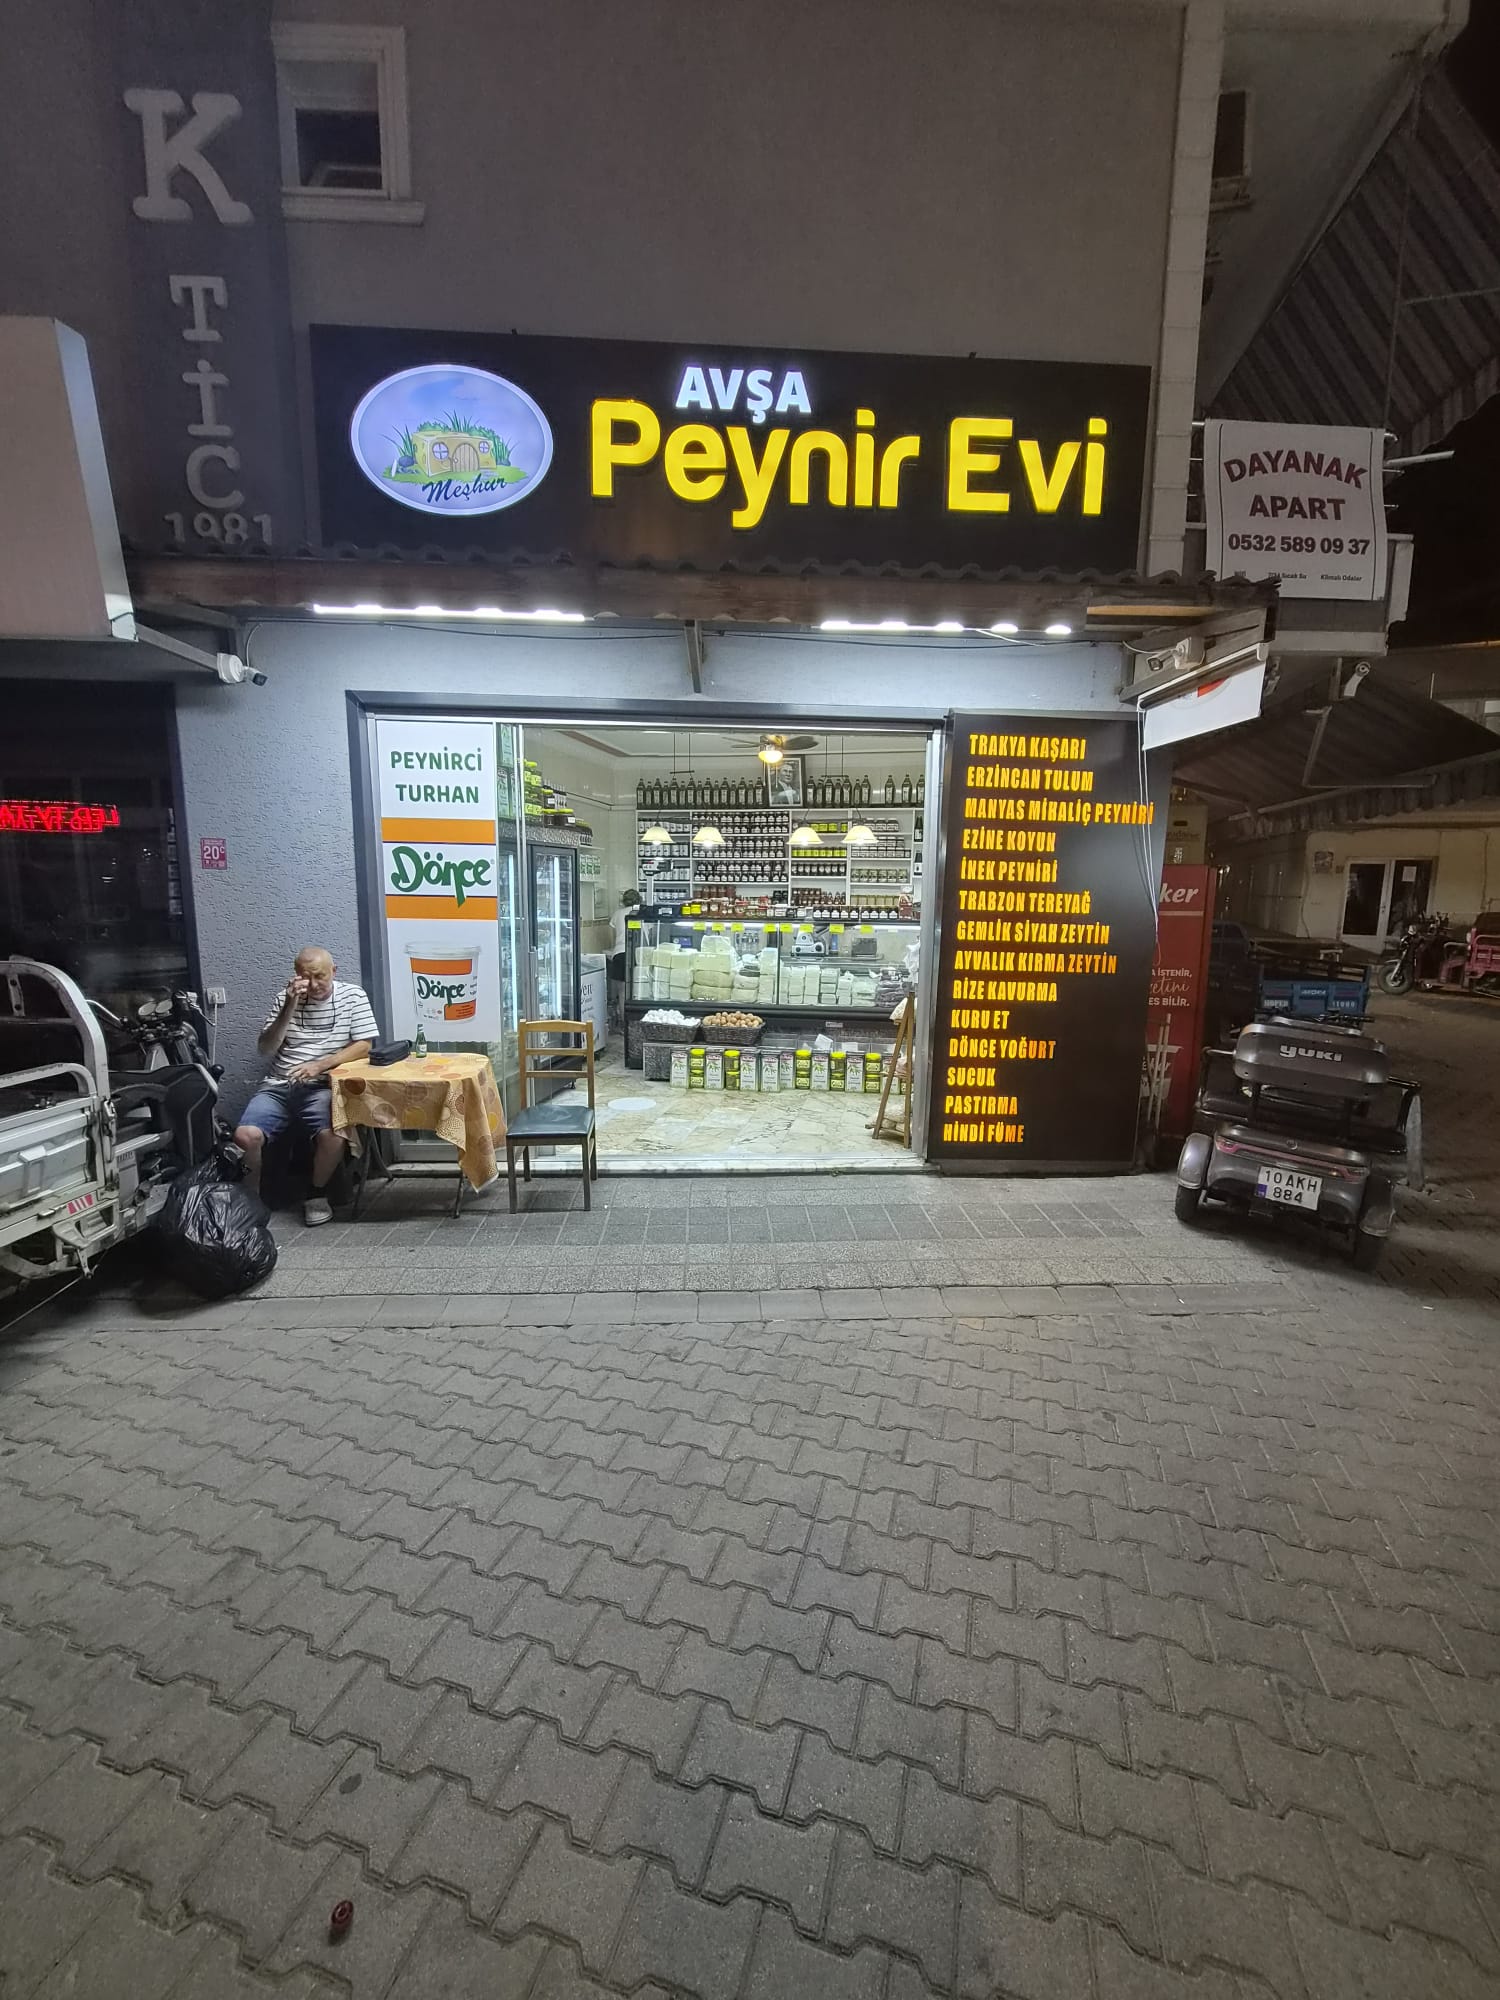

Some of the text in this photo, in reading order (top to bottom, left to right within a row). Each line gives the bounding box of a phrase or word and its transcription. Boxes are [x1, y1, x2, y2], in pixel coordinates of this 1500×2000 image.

[123, 88, 254, 224] K
[676, 366, 811, 423] AVŞA
[591, 400, 1107, 529] Peynir Evi
[1224, 450, 1368, 489] DAYANAK
[422, 473, 507, 503] Meşhur
[1249, 494, 1345, 521] APART
[164, 511, 272, 546] 1981
[1228, 533, 1370, 555] 0532 589 09 37
[390, 746, 482, 771] PEYNİRCİ
[970, 734, 1086, 762] TRAKYA KAŞARI
[967, 764, 1094, 792] ERZİNCAN TULUM
[395, 784, 479, 804] TURHAN
[965, 797, 1154, 826] MANYAS MİHALİÇ PEYNİRİ
[962, 826, 1056, 852] EZİNE KOYUN
[960, 856, 1058, 883] İNEK PEYNİRİ
[959, 890, 1092, 914] TRABZON TEREYAĞ
[1160, 882, 1199, 903] ker
[957, 919, 1110, 945] GEMLİK SİYAH ZEYTİN
[954, 950, 1117, 974] AYVALIK KIRMA ZEYTİN
[953, 977, 1057, 1002] RİZE KAVURMA
[1148, 996, 1190, 1007] ES BİLİR.
[951, 1009, 1010, 1029] KURU ET
[949, 1035, 1056, 1059] DÖNCE YOĞURT
[1280, 1044, 1343, 1062] yuki
[947, 1067, 996, 1087] SUCUK
[944, 1095, 1018, 1115] PASTIRMA
[943, 1120, 1024, 1143] HİNDİ FÜME
[1265, 1170, 1318, 1193] 10 AKH
[1273, 1186, 1303, 1204] 884
